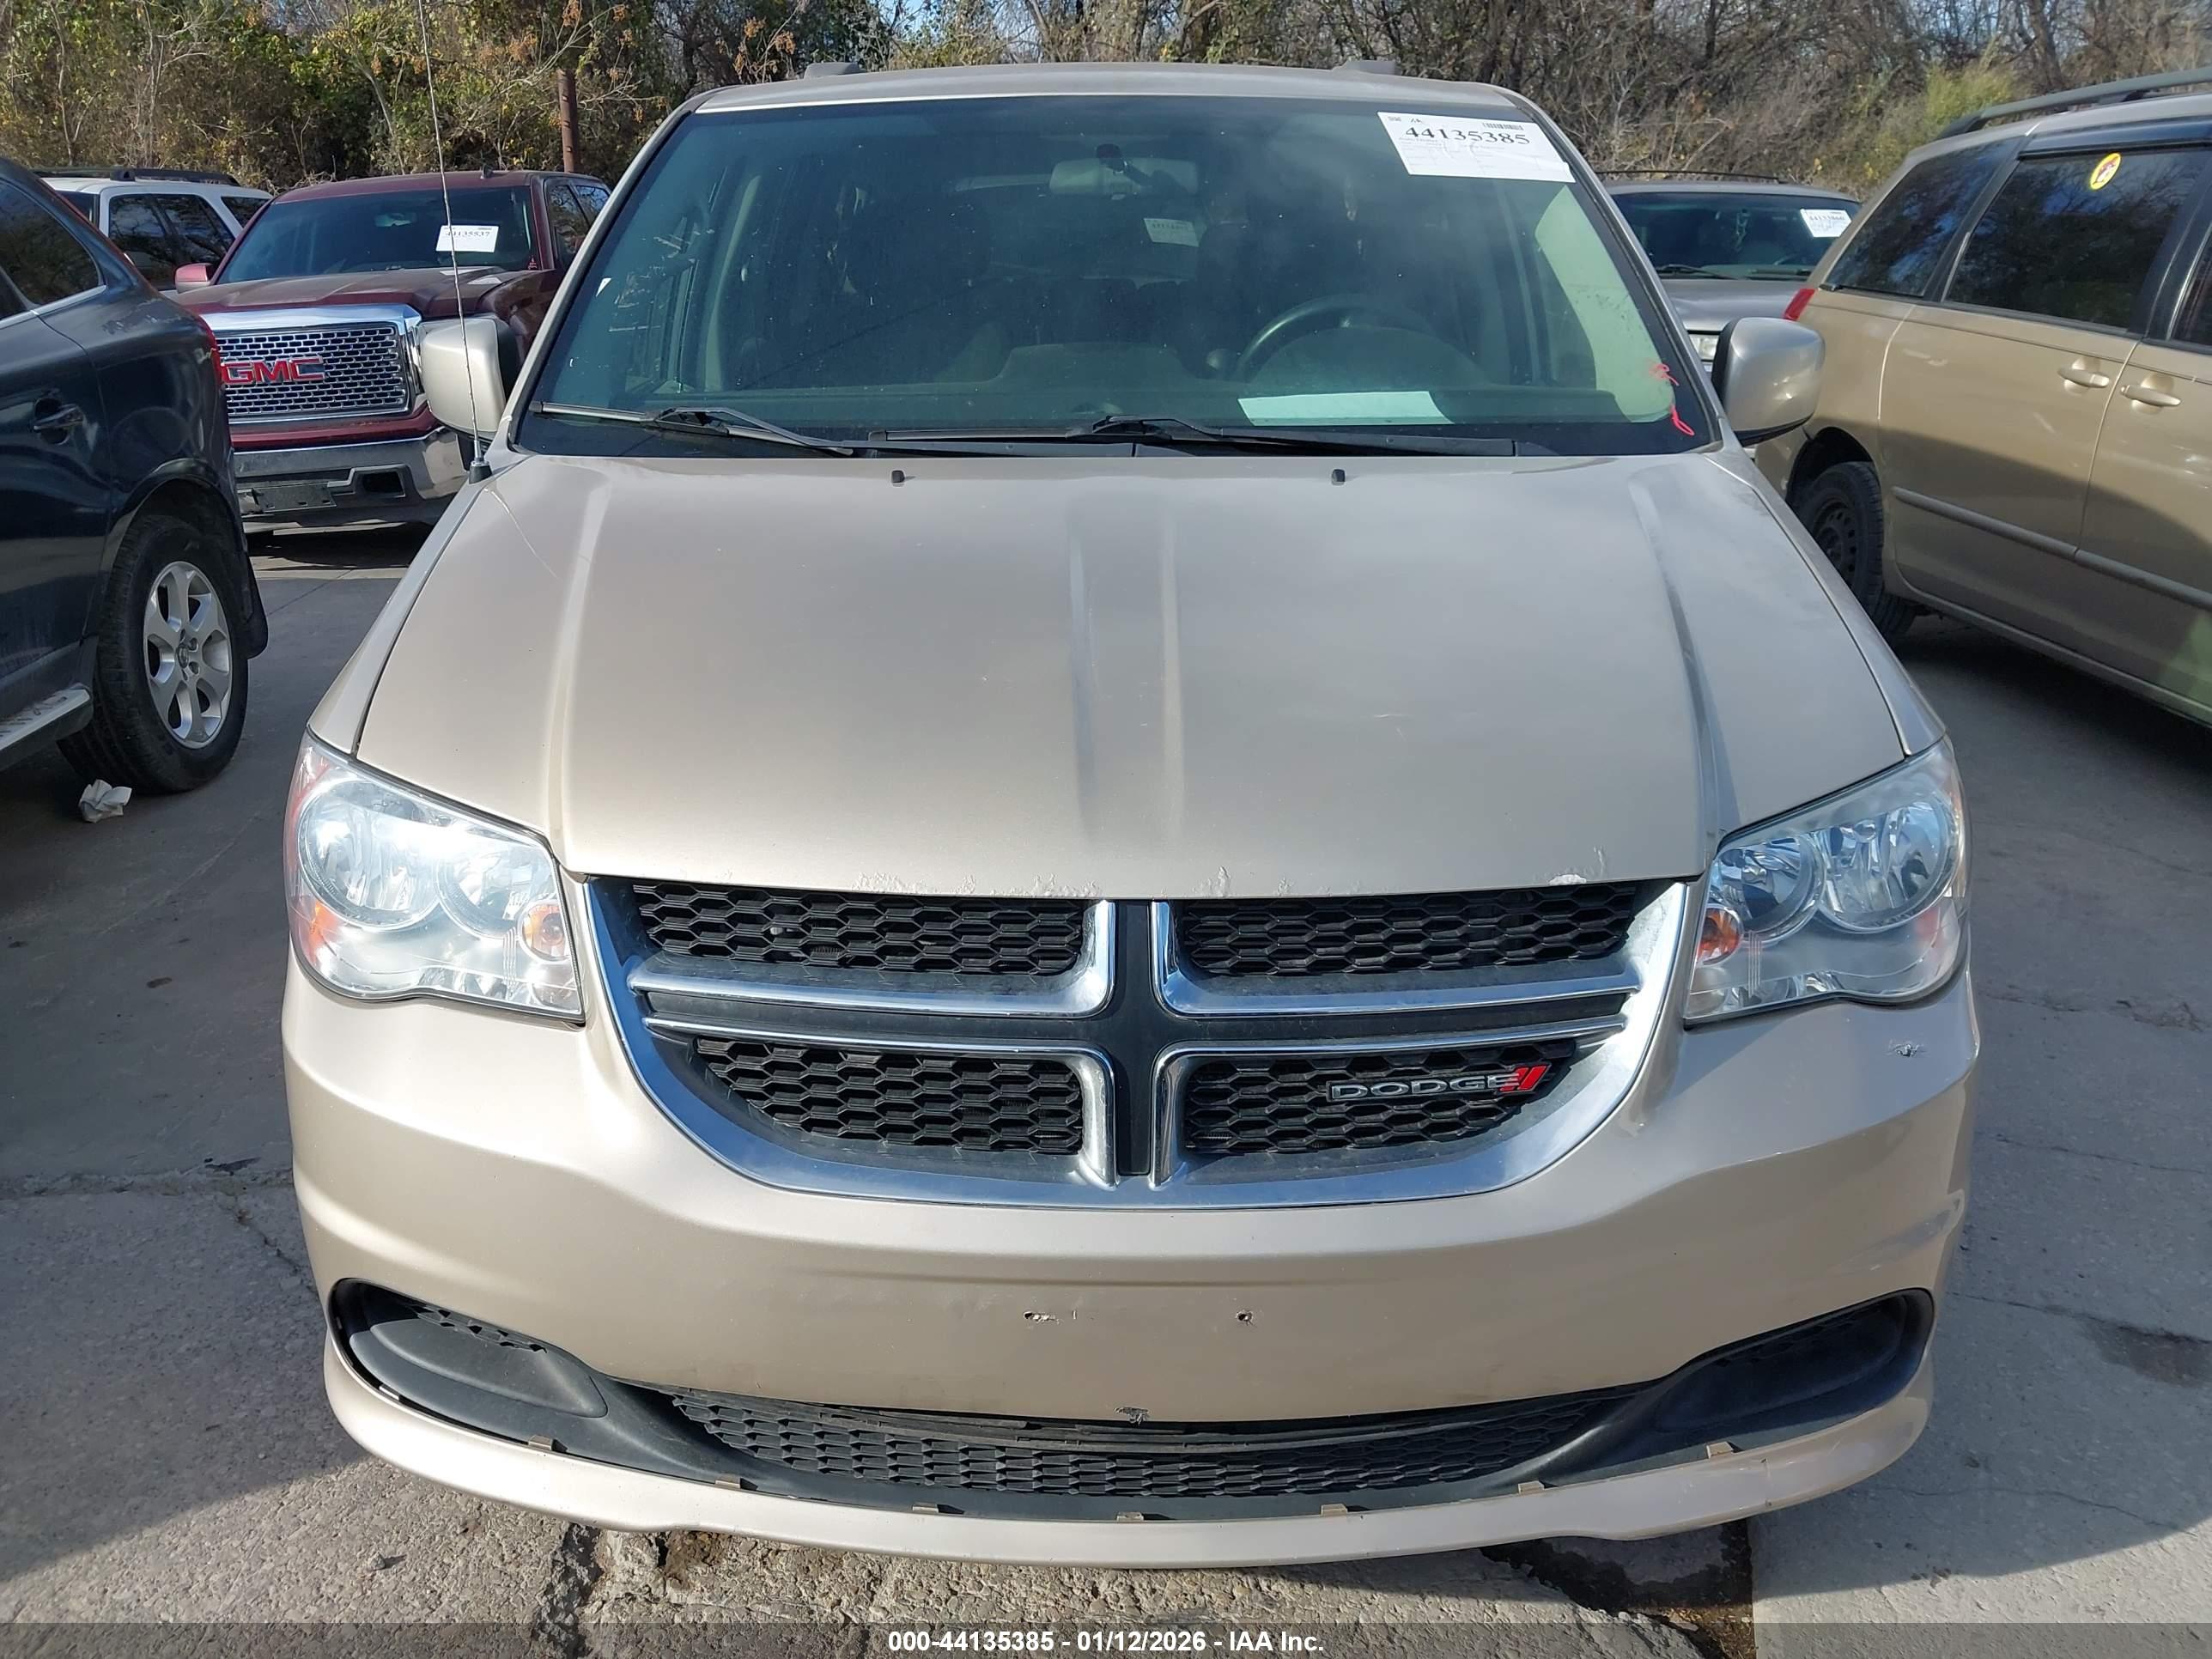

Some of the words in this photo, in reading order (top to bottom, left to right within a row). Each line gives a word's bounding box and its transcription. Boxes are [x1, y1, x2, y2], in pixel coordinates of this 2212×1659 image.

[1406, 126, 1531, 145] 44135385
[220, 356, 325, 386] GMC
[1331, 1073, 1520, 1099] DODGE
